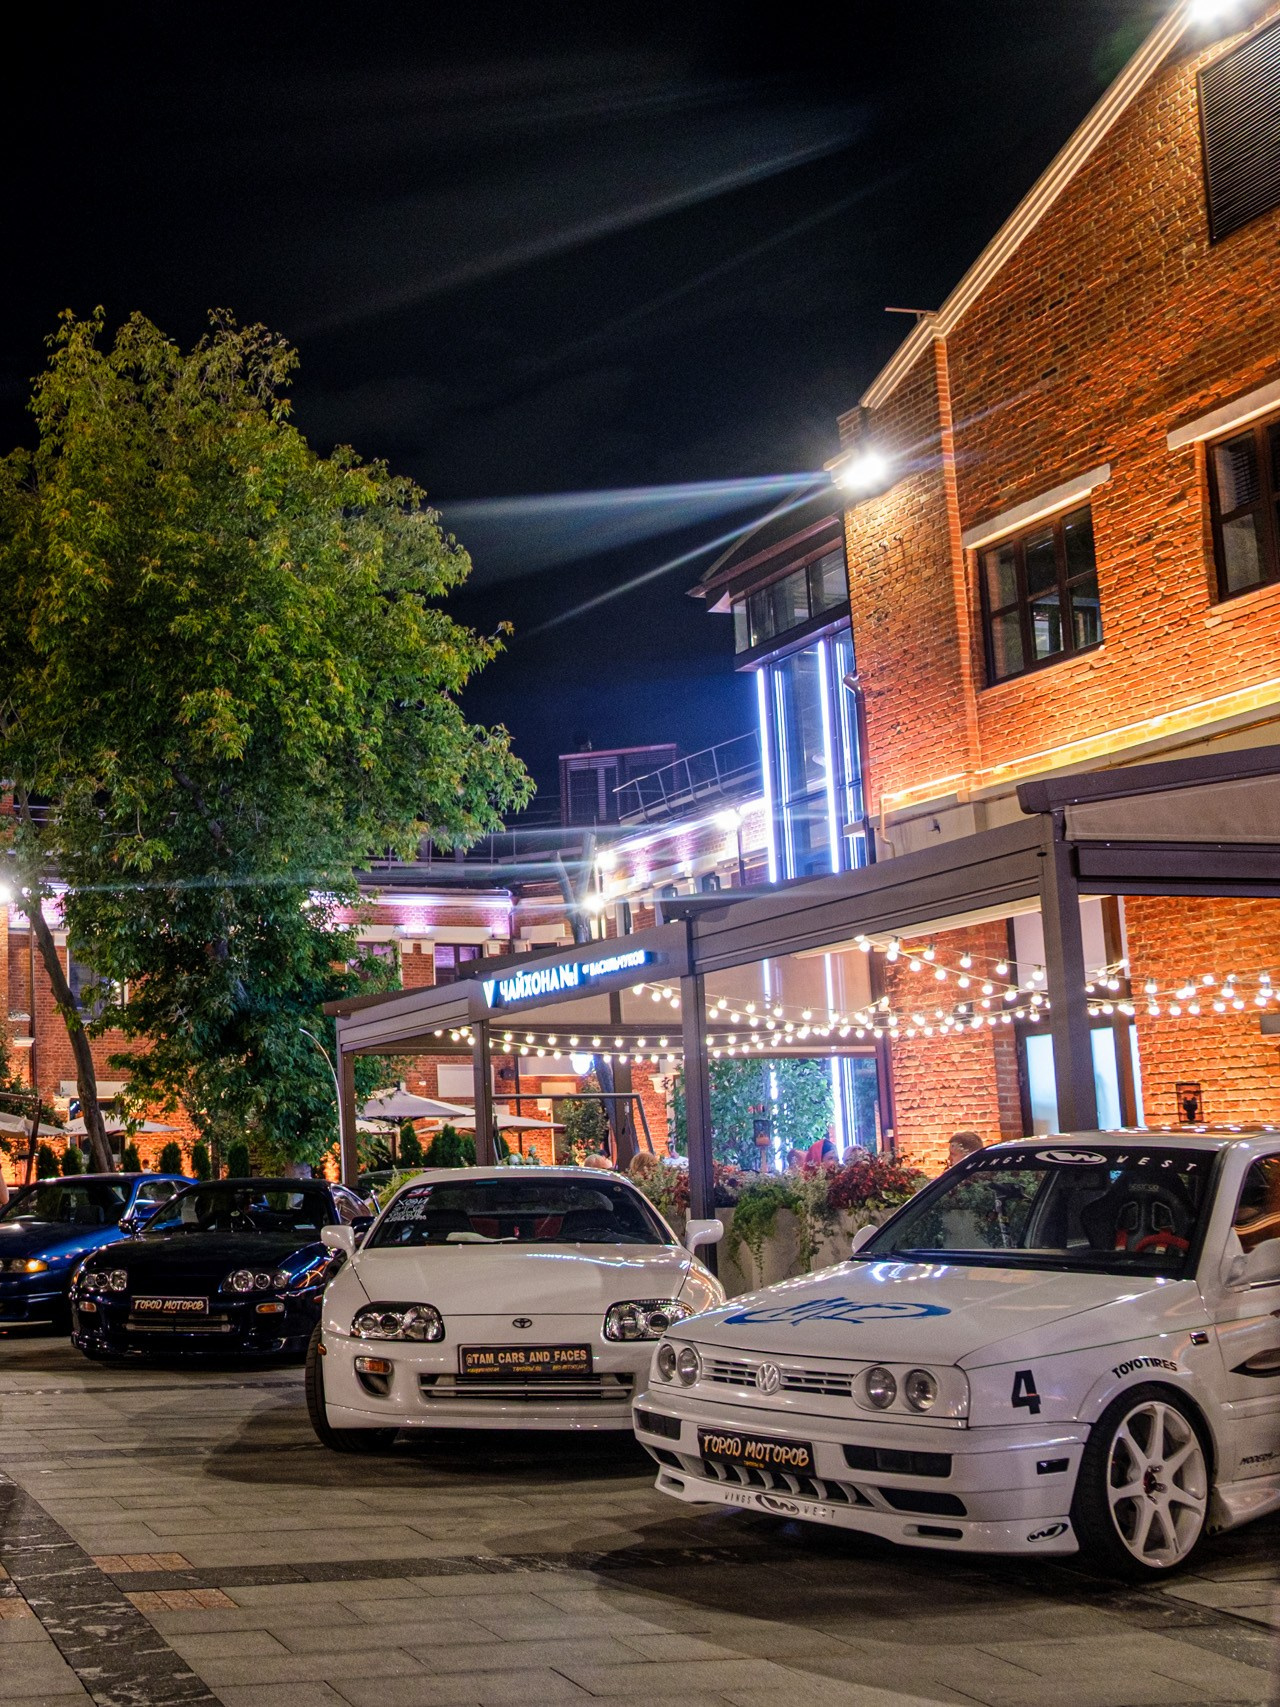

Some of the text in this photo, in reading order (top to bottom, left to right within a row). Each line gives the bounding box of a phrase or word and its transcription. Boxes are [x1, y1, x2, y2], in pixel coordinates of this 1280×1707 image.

[500, 967, 559, 1001] ЧАЙХОНА
[1117, 1155, 1197, 1172] WEST
[163, 1300, 205, 1311] МОТОРОВ
[1011, 1369, 1041, 1415] 4
[745, 1441, 810, 1467] МОТОРОВ
